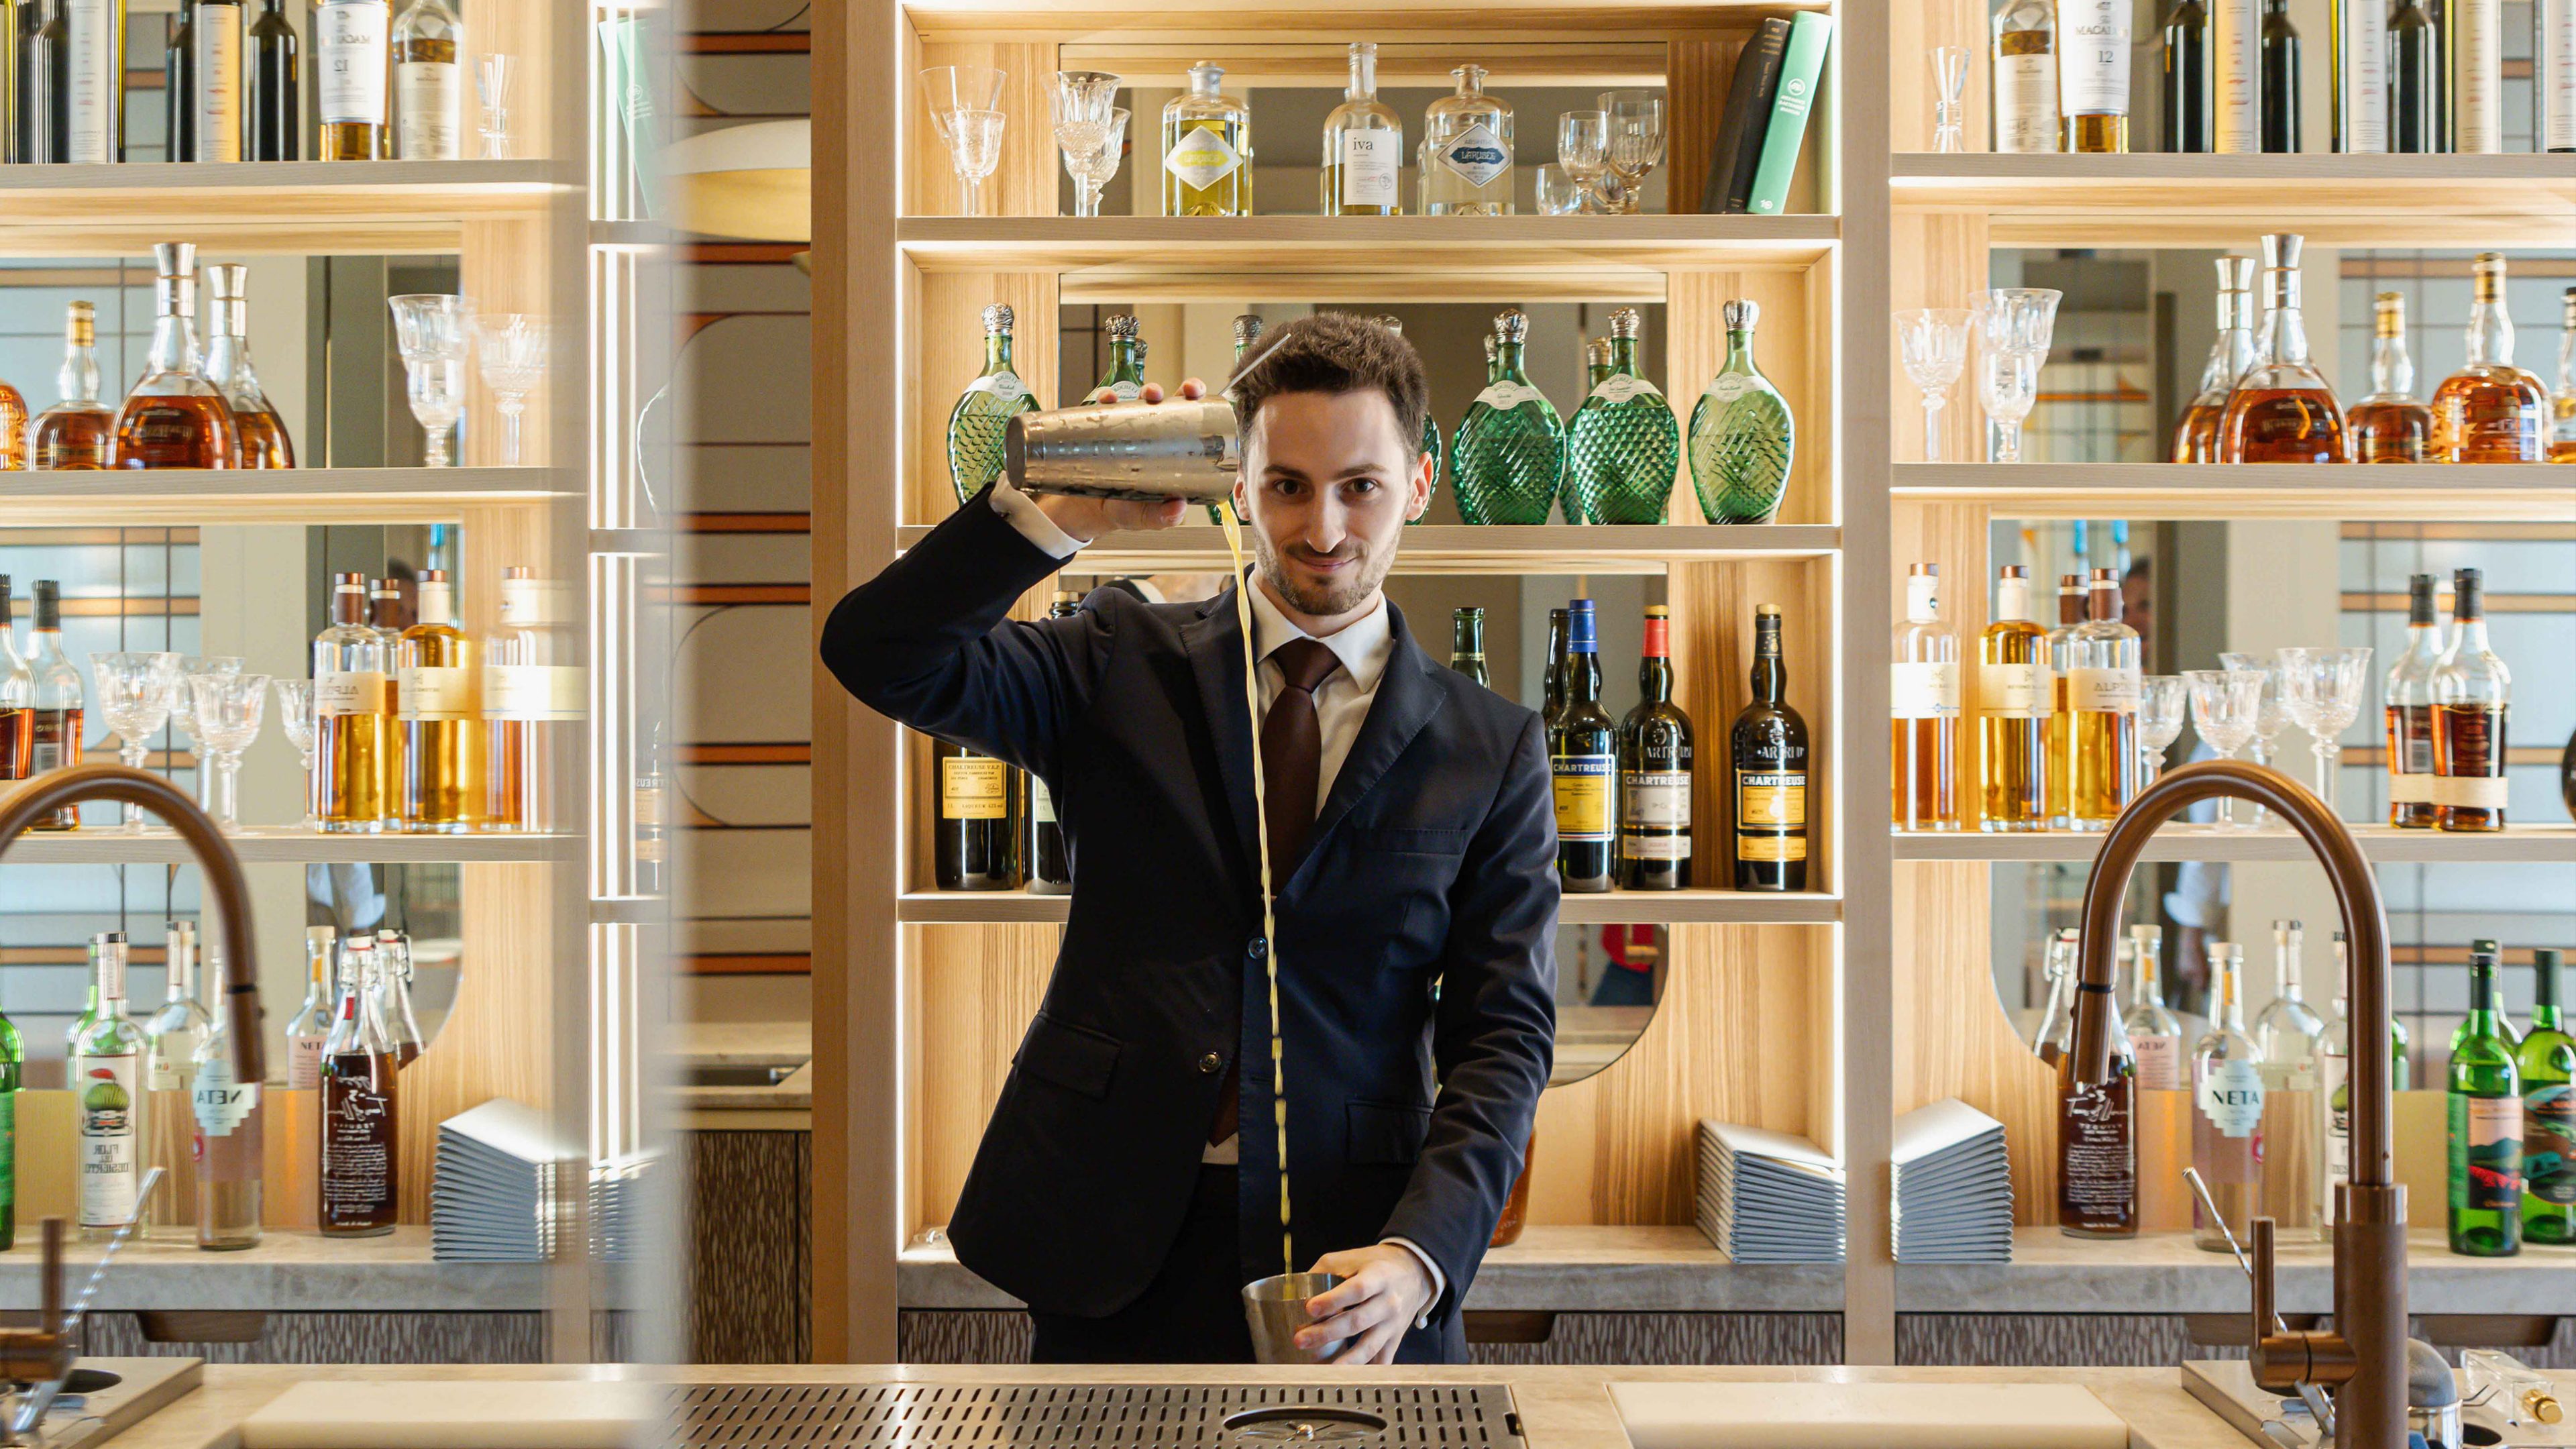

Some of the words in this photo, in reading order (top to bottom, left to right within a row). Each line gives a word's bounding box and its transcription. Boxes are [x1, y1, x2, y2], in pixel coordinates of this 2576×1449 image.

[2098, 50, 2114, 62] 12
[1353, 138, 1373, 150] iva
[1554, 764, 1611, 772] CHARTREUSE
[1626, 775, 1689, 786] CHARTREUSE
[1742, 775, 1806, 786] CHARTREUSE
[301, 1042, 322, 1051] NET
[2212, 1091, 2259, 1105] NETA
